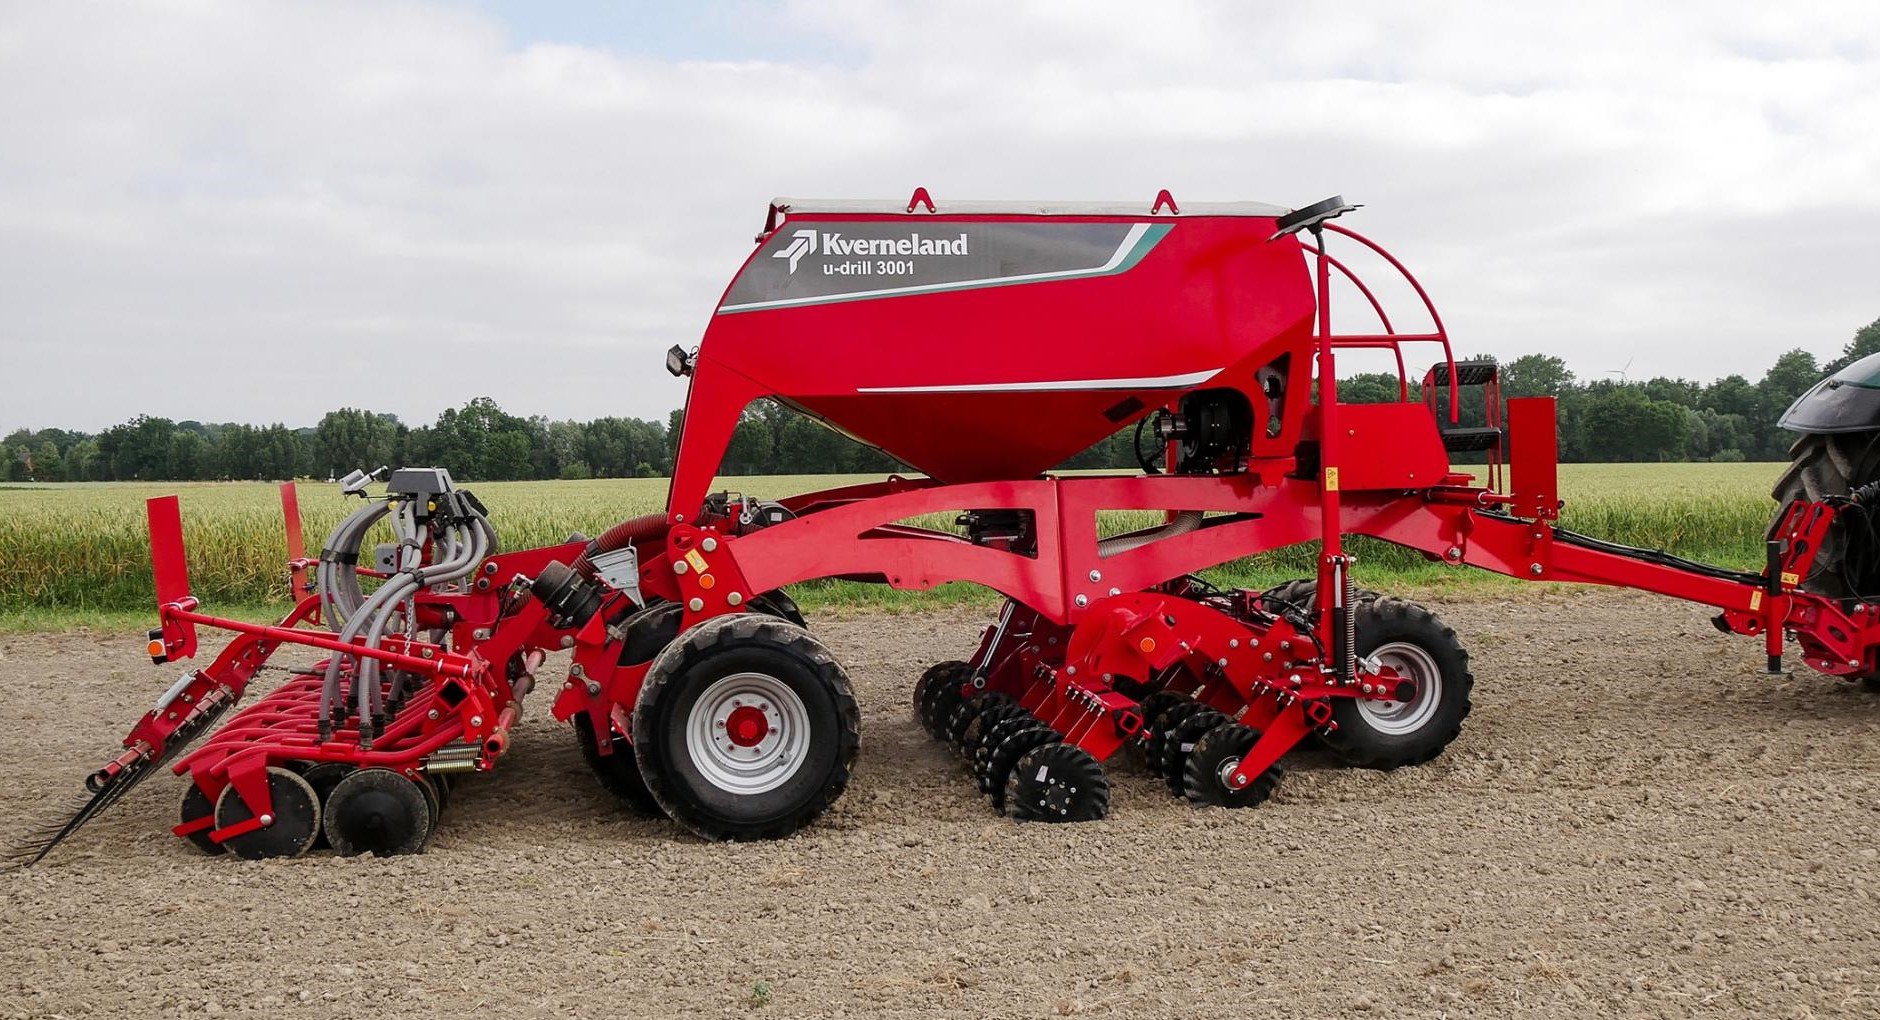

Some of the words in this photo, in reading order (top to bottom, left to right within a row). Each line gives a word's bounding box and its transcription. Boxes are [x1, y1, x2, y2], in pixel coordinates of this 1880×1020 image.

[822, 233, 968, 255] Kverneland
[823, 260, 872, 275] u-drill
[876, 260, 914, 275] 3001
